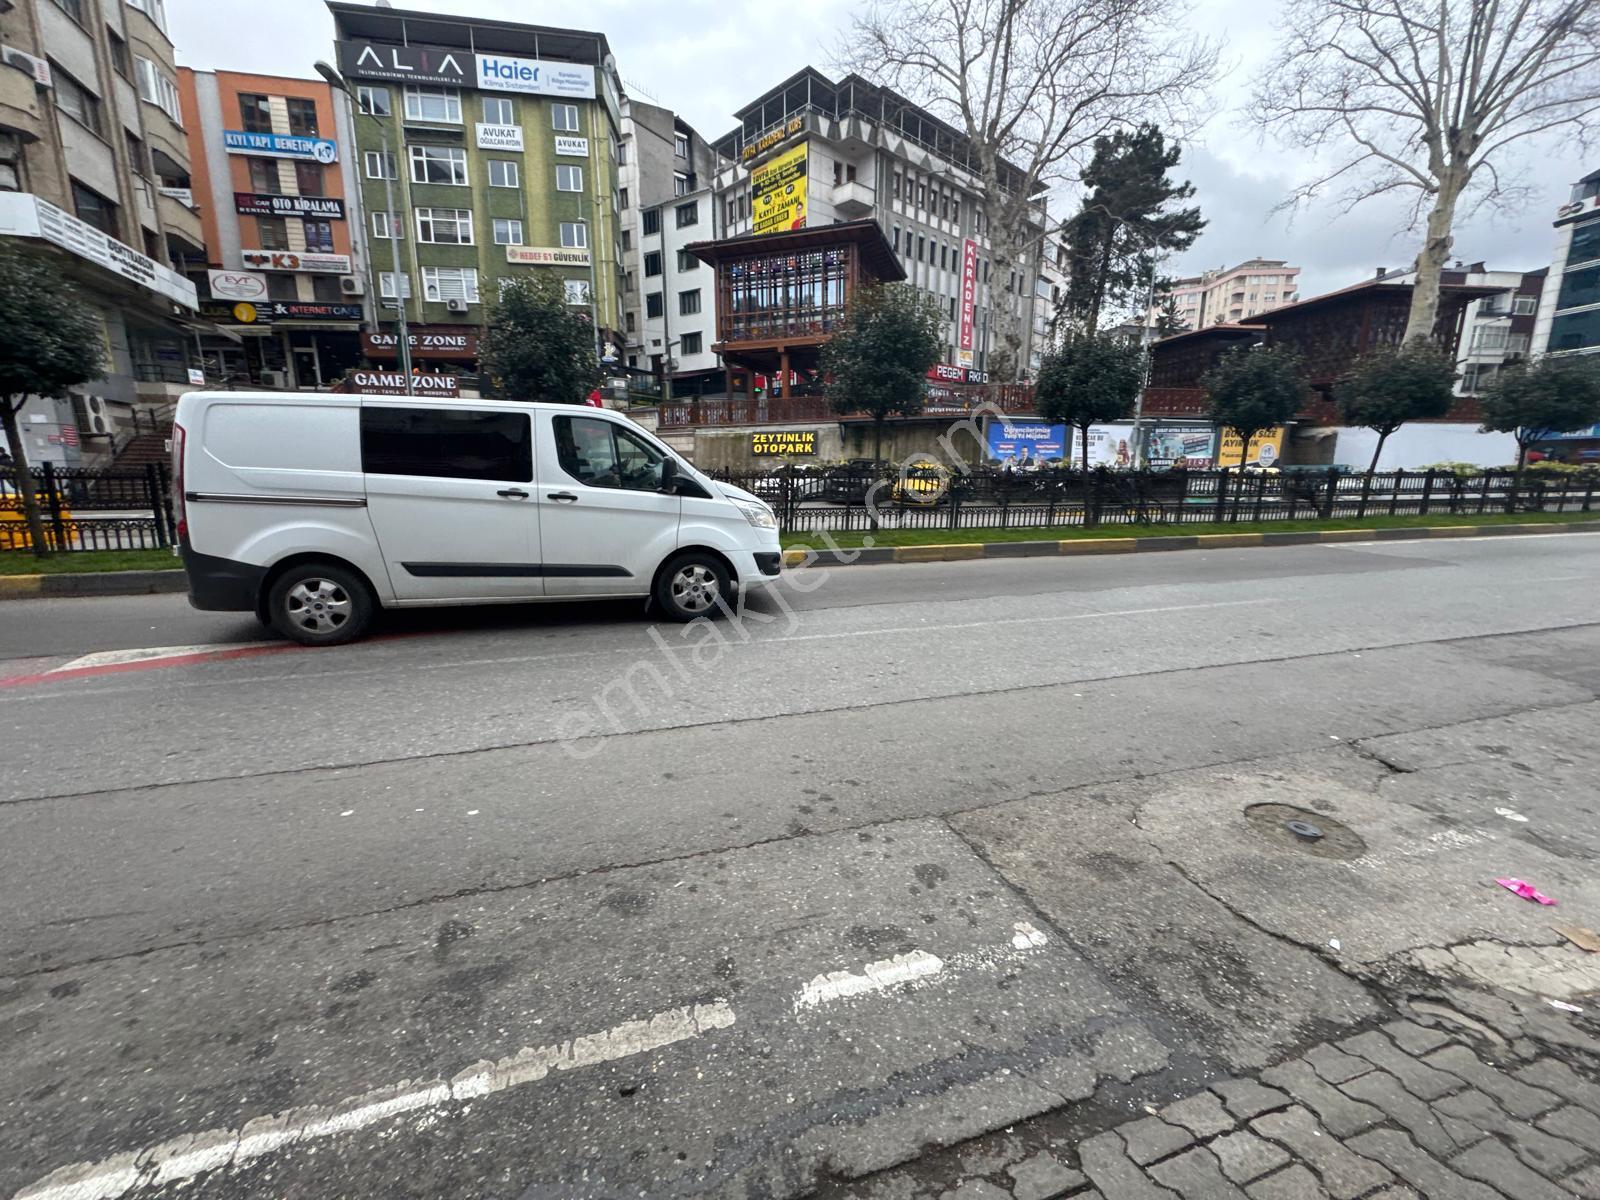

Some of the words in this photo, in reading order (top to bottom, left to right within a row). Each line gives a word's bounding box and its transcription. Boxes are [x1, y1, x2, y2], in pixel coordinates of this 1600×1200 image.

[482, 58, 540, 81] Haier
[483, 79, 504, 88] Klima
[483, 127, 517, 138] AVUKAT
[249, 135, 271, 148] YAPI
[557, 139, 587, 148] AVUKAT
[272, 198, 291, 209] OTO
[294, 197, 340, 212] KİRALAMA
[553, 252, 589, 263] GÜVENLİK
[962, 244, 974, 345] KARADENİZ
[422, 335, 467, 346] ZONE
[937, 365, 964, 380] PEGEM
[354, 373, 405, 387] GAME
[411, 375, 456, 389] ZONE
[752, 431, 815, 443] ZEYTİNLİK
[753, 443, 813, 453] OTOPARK
